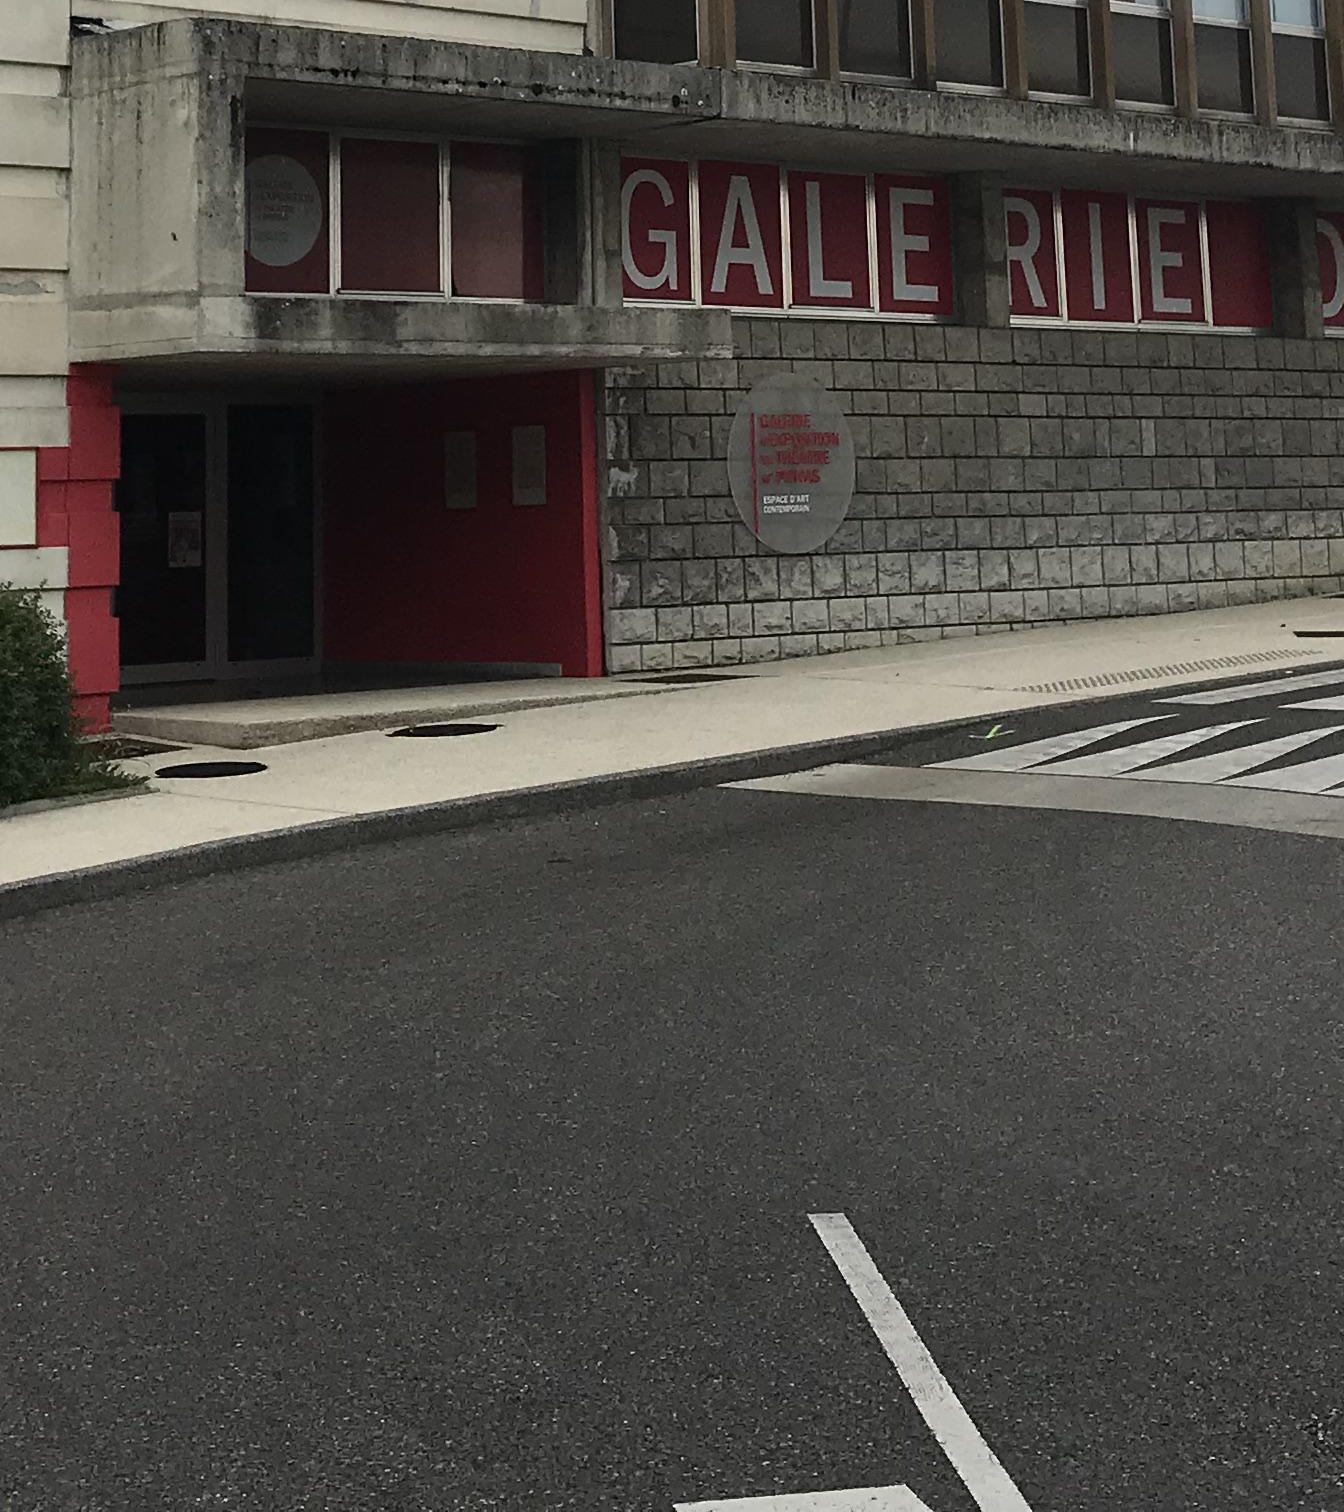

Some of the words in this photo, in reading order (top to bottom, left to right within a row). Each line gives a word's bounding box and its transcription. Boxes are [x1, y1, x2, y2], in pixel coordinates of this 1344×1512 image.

[621, 168, 1192, 314] GALERIE
[763, 495, 788, 504] ESPACE
[790, 494, 809, 504] D'ART
